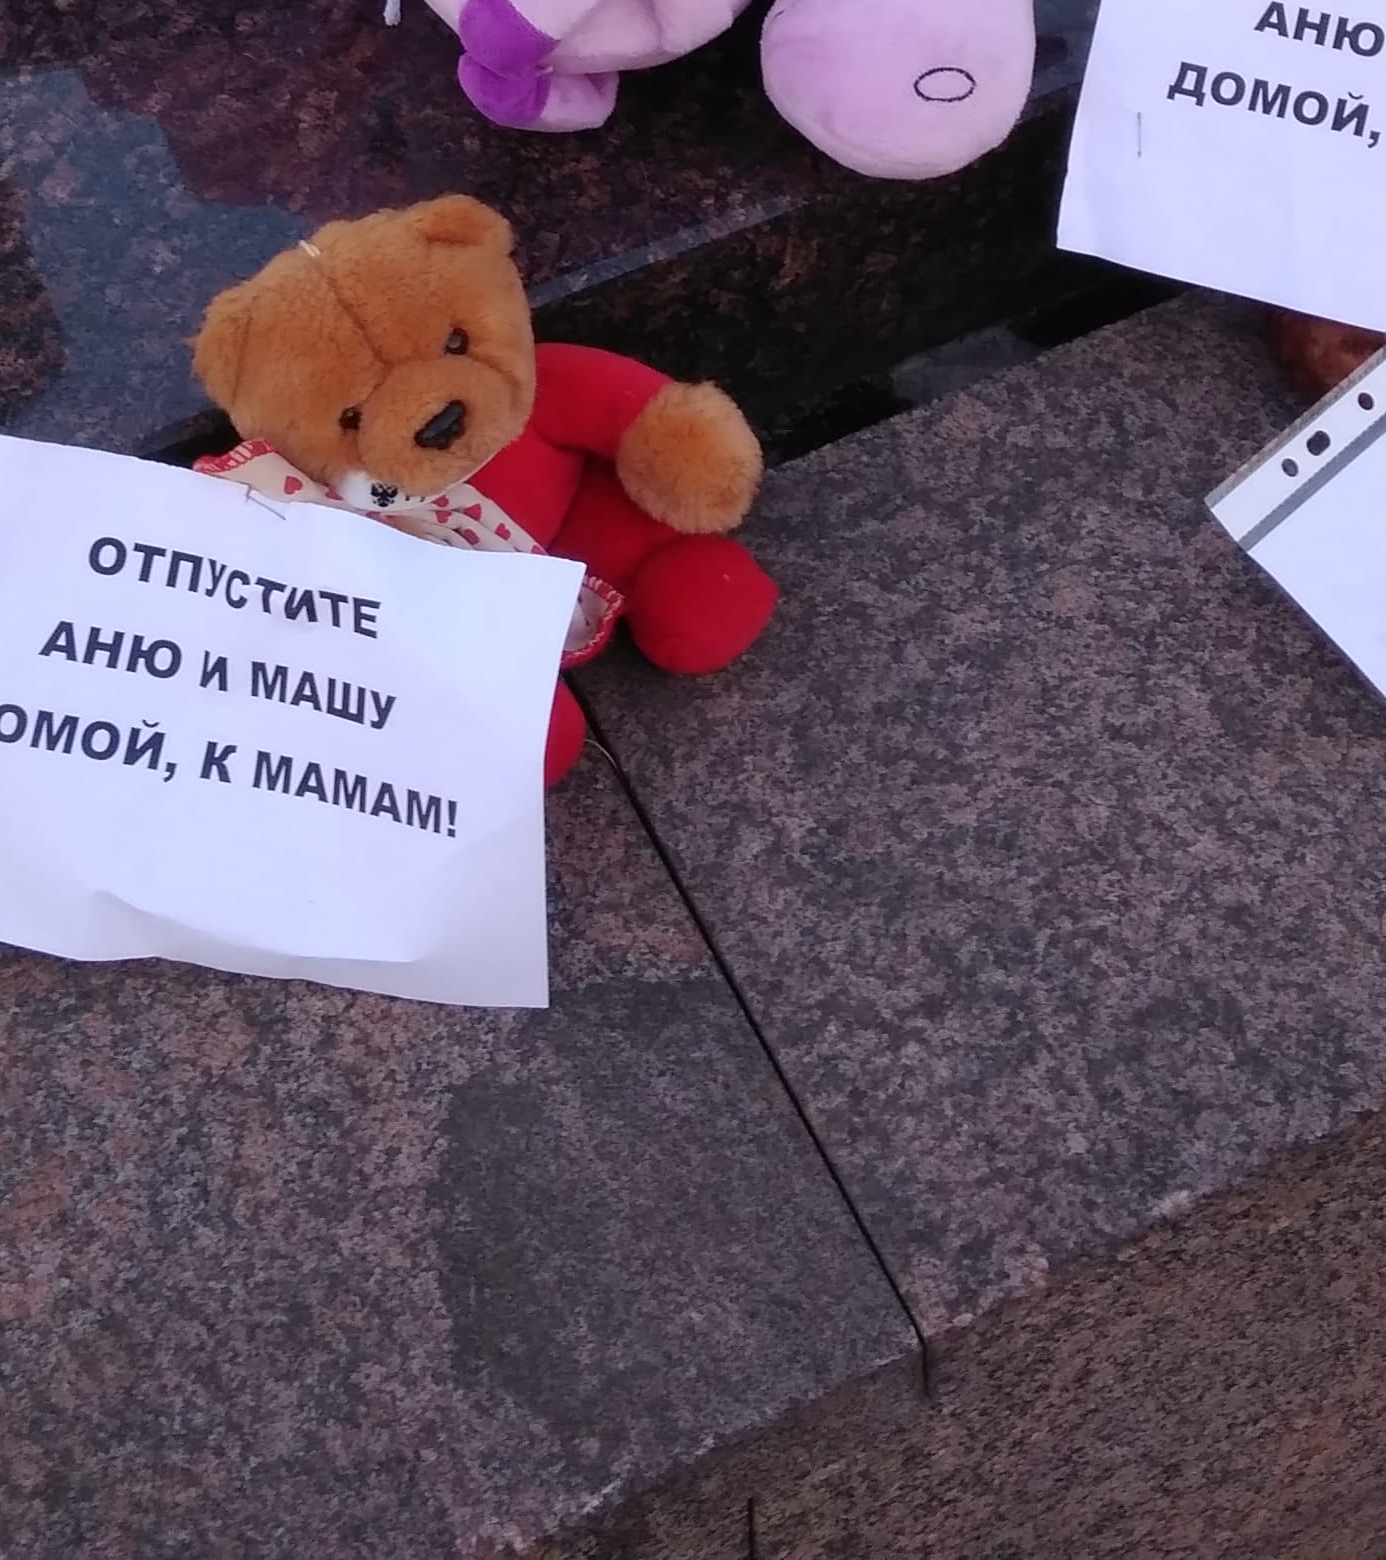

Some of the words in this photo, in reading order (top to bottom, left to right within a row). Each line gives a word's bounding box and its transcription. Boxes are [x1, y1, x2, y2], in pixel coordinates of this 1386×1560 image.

[1254, 1, 1385, 57] АНЮ
[1166, 62, 1381, 148] ДОМОЙ,
[89, 537, 381, 639] ОТПУСТИТЕ
[38, 621, 182, 678] АНЮ
[199, 650, 228, 692] И
[251, 661, 397, 729] МАШУ
[200, 741, 237, 783] К
[253, 750, 457, 838] МАМАМ!
